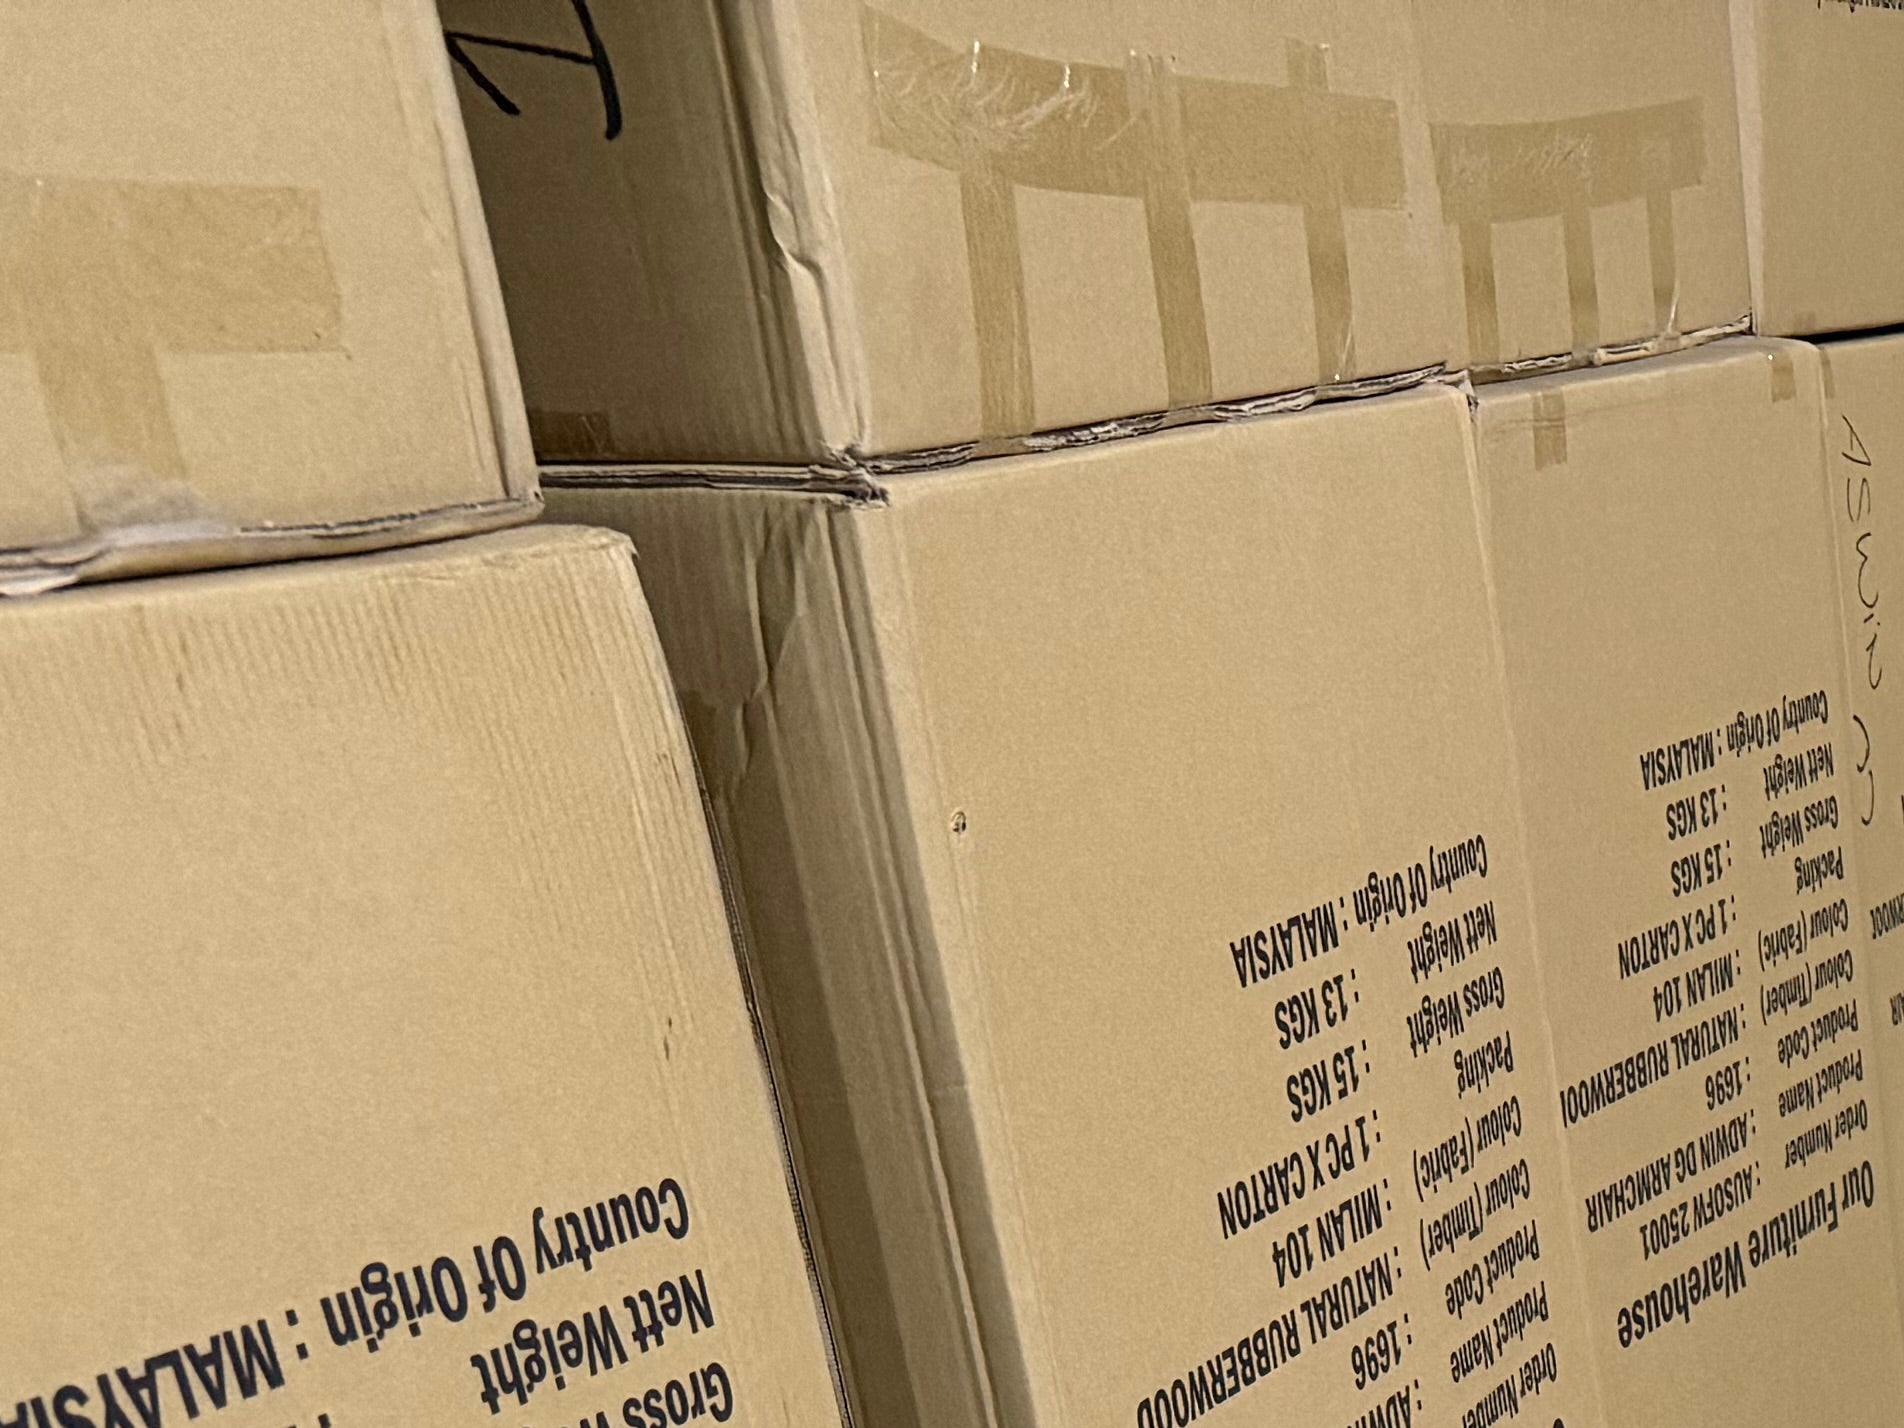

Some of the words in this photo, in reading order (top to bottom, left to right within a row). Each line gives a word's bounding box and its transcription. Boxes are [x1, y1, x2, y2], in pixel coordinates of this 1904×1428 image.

[1725, 710, 1764, 757] Origin
[1766, 706, 1780, 746] Of
[1782, 689, 1827, 733] Country
[1639, 729, 1714, 790] MALAYSIA
[1407, 862, 1427, 913] Of
[1429, 834, 1487, 893] Country
[1794, 846, 1843, 895] Packing
[1351, 871, 1406, 931] Origin
[1695, 903, 1715, 944] PC
[1717, 897, 1727, 934] 1
[1228, 900, 1338, 987] MALAYSIA
[1617, 919, 1680, 979] CARTON
[1681, 912, 1693, 951] X
[1462, 966, 1504, 1016] Gross
[1405, 990, 1464, 1057] Weight
[1286, 1059, 1331, 1121] KGS
[1332, 1044, 1358, 1099] 15
[1784, 1118, 1833, 1169] Number
[1834, 1098, 1867, 1139] Order
[1485, 1157, 1529, 1216] Colour
[1693, 1163, 1751, 1231] AUSOFW
[1841, 1159, 1873, 1211] Our
[531, 1178, 688, 1273] Country
[1417, 1182, 1483, 1270] (Timber)
[1639, 1200, 1689, 1260] 25001
[1747, 1180, 1838, 1267] Furniture
[472, 1235, 525, 1312] Of
[1300, 1251, 1391, 1344] NATURAL
[1618, 1240, 1746, 1347] Warehouse
[320, 1256, 467, 1352] Origin
[1492, 1280, 1547, 1356] Product
[1448, 1324, 1494, 1383] Name
